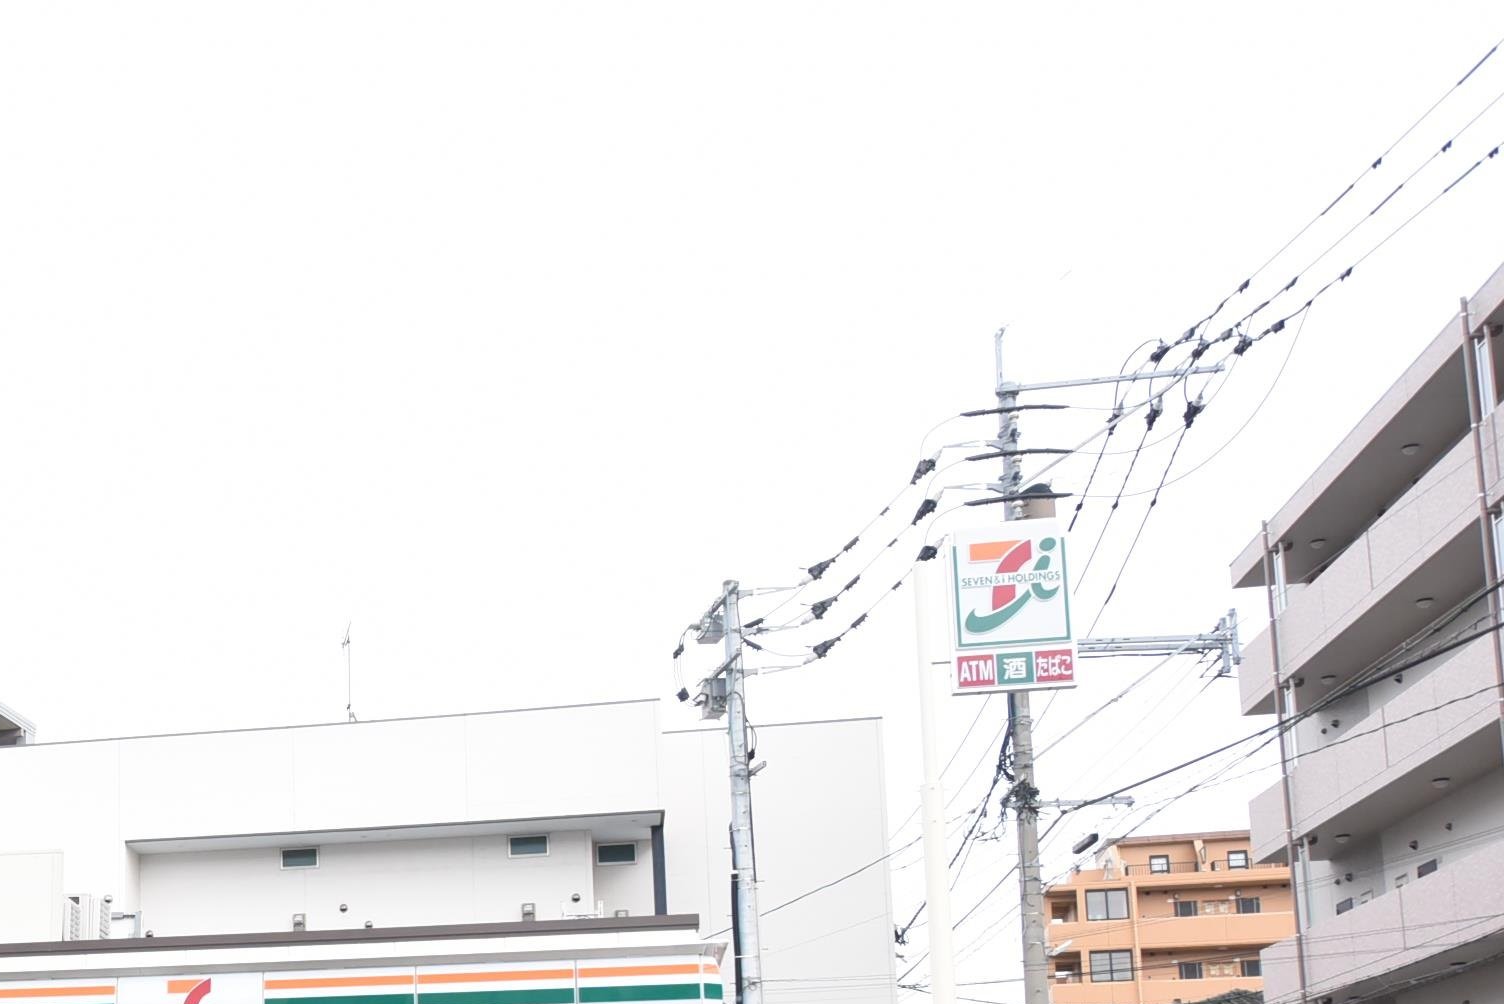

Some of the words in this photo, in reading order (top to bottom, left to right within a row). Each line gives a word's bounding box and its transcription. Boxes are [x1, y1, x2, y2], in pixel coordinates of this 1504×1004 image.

[1007, 570, 1061, 584] HOLDINGS
[959, 660, 994, 682] ATM
[1003, 657, 1026, 679] 酒
[1036, 655, 1073, 677] たばこ
